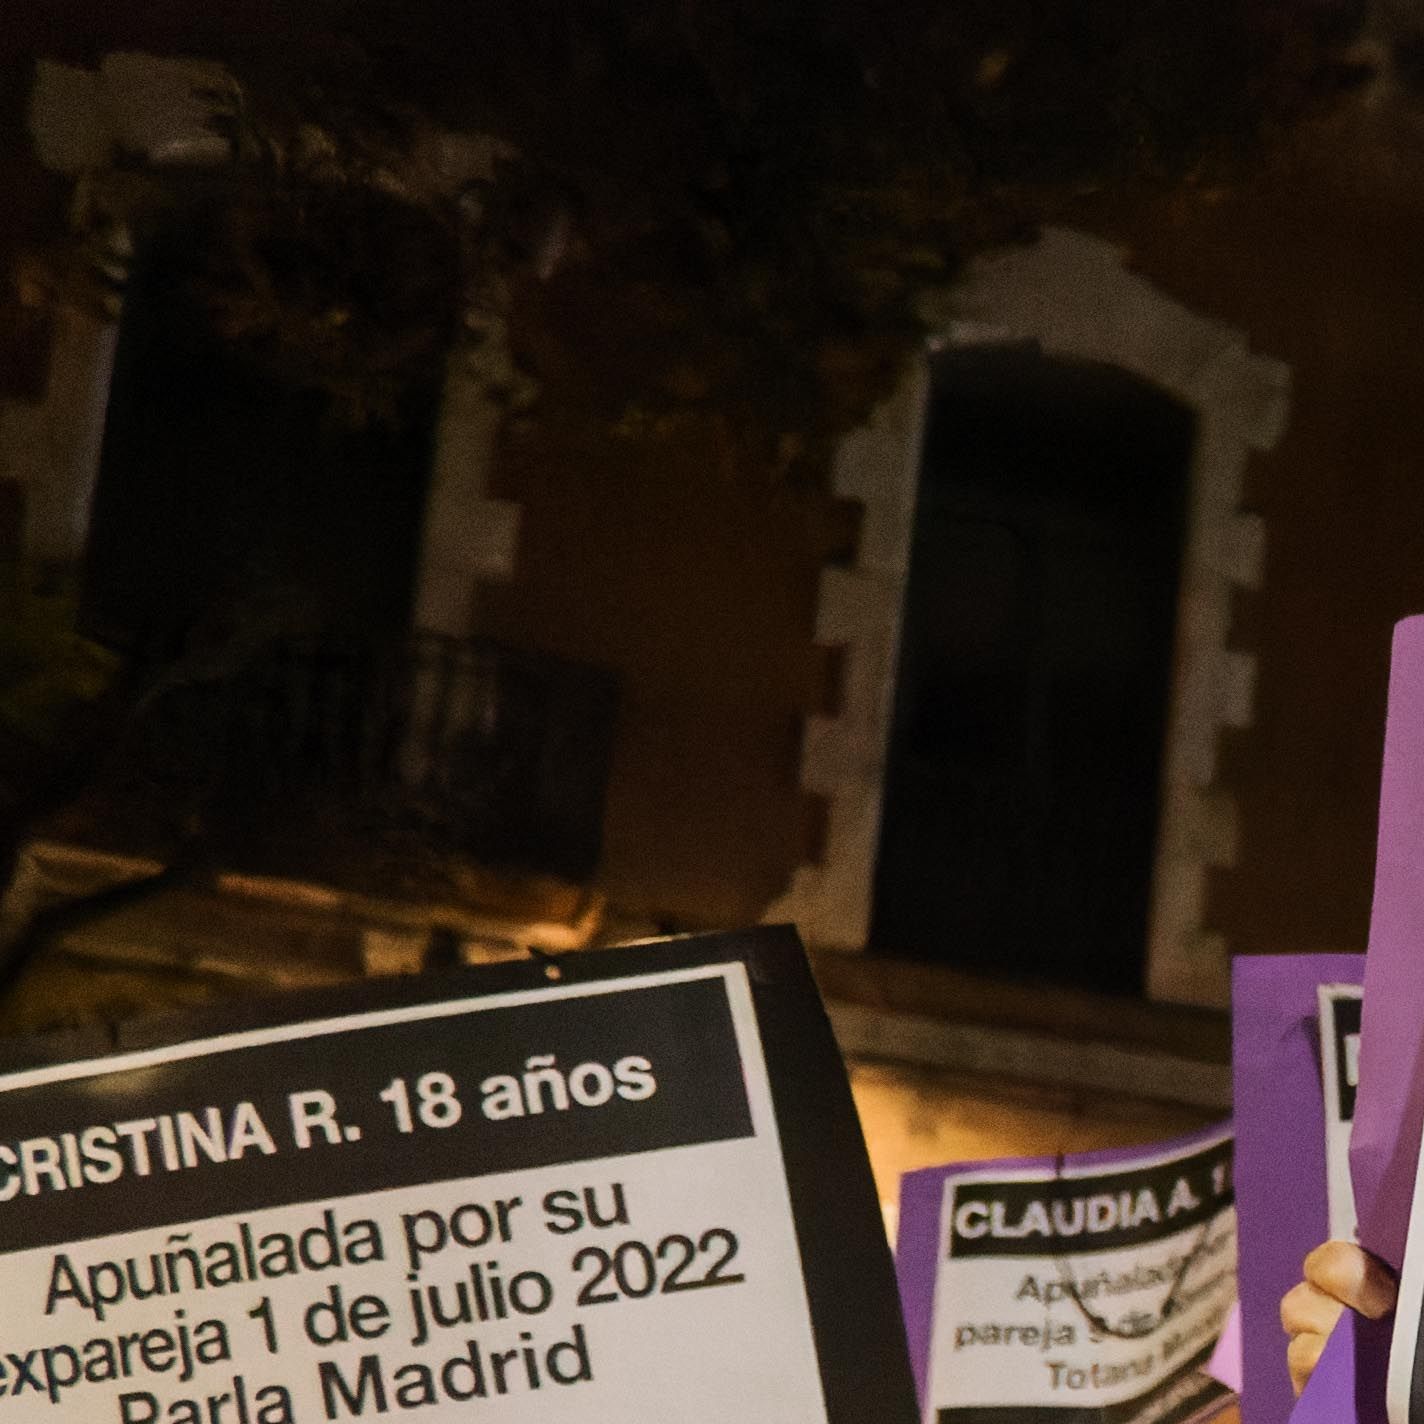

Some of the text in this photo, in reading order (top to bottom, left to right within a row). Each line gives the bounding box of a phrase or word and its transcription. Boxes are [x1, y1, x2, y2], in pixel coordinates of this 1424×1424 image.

[289, 1090, 362, 1149] R.
[380, 1072, 462, 1133] 18
[479, 1054, 657, 1121] años
[45, 1183, 629, 1322] Apuñalada por su
[955, 1188, 1160, 1239] CLAUDIA
[0, 1227, 745, 1404] xpareja 1 de julio 2022
[318, 1324, 593, 1420] Madrid
